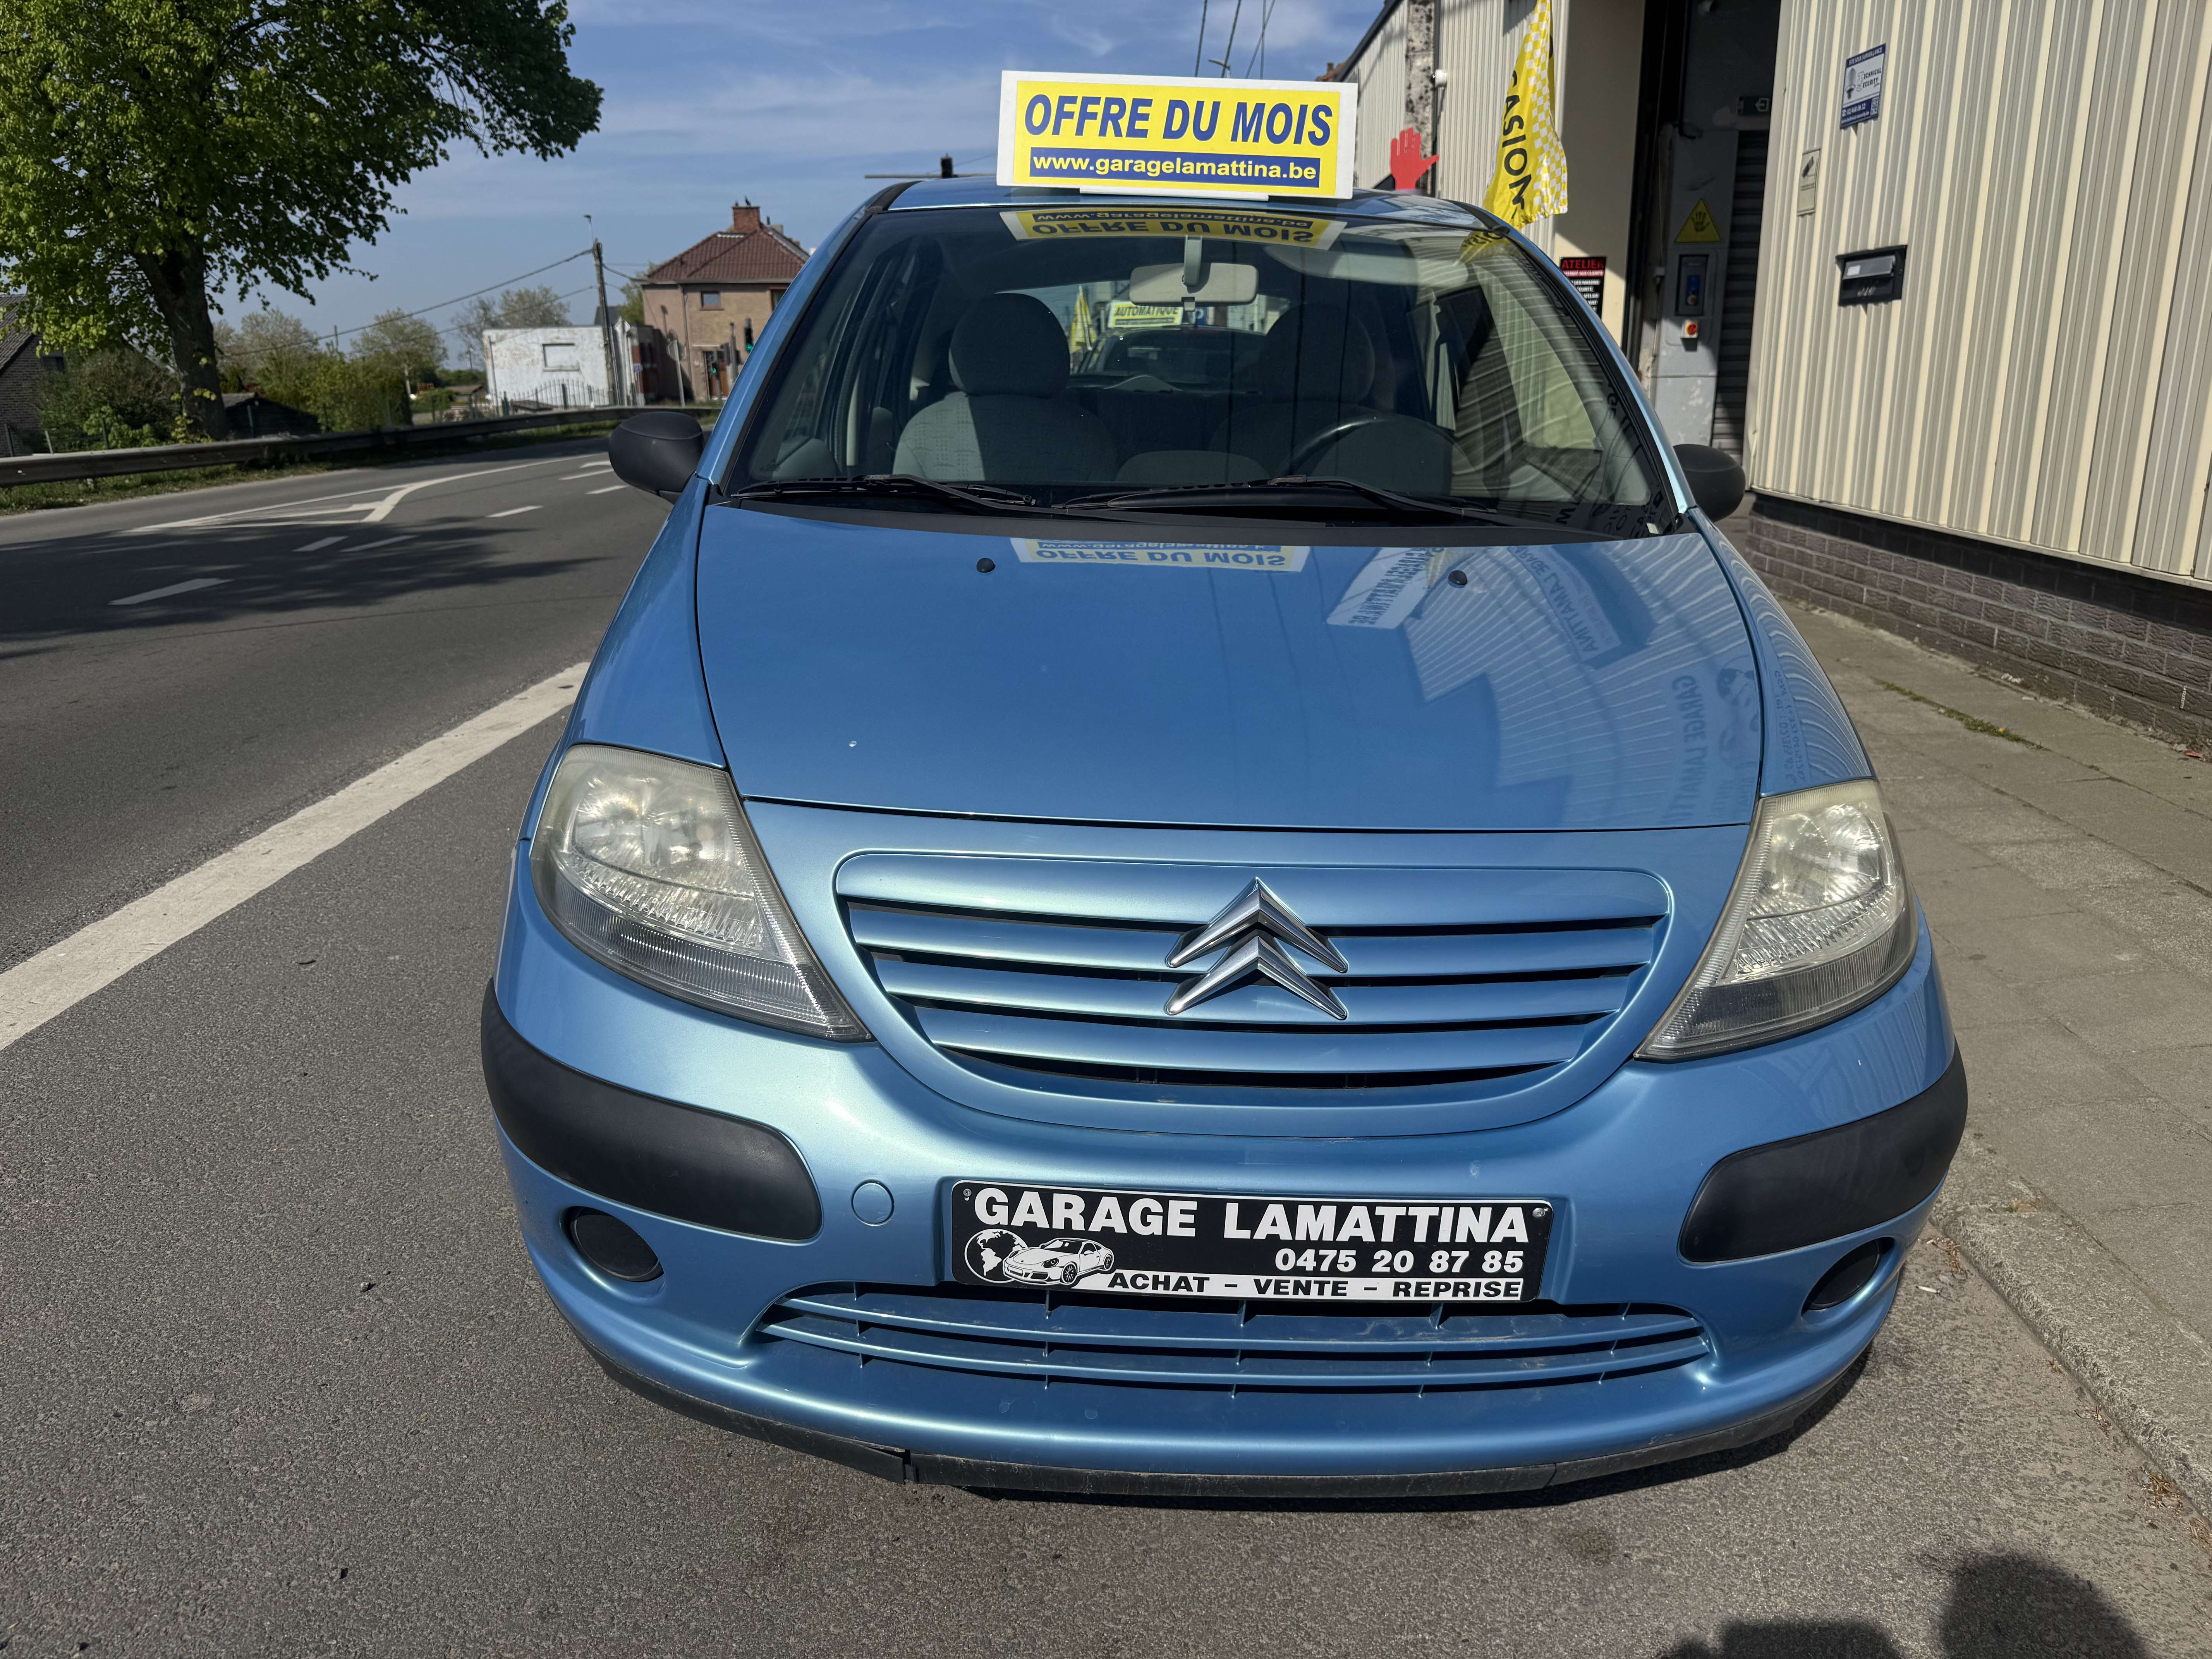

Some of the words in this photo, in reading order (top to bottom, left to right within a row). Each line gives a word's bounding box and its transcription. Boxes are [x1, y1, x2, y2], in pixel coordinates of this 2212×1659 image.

[1025, 94, 1153, 139] OFFRE
[1162, 99, 1220, 141] DU
[1230, 101, 1333, 146] MOIS
[1033, 155, 1317, 180] www.garagelamattina.be
[1561, 260, 1604, 269] ATELIER
[974, 1187, 1197, 1237] GARAGE
[1223, 1202, 1528, 1242] LAMATTINA
[1274, 1248, 1356, 1271] 0475
[1371, 1250, 1414, 1273] 20
[1429, 1250, 1469, 1273] 87
[1481, 1250, 1523, 1273] 85
[1107, 1272, 1210, 1293] ACHAT
[1253, 1278, 1348, 1296] VENTE
[1393, 1281, 1522, 1298] REPRISE
